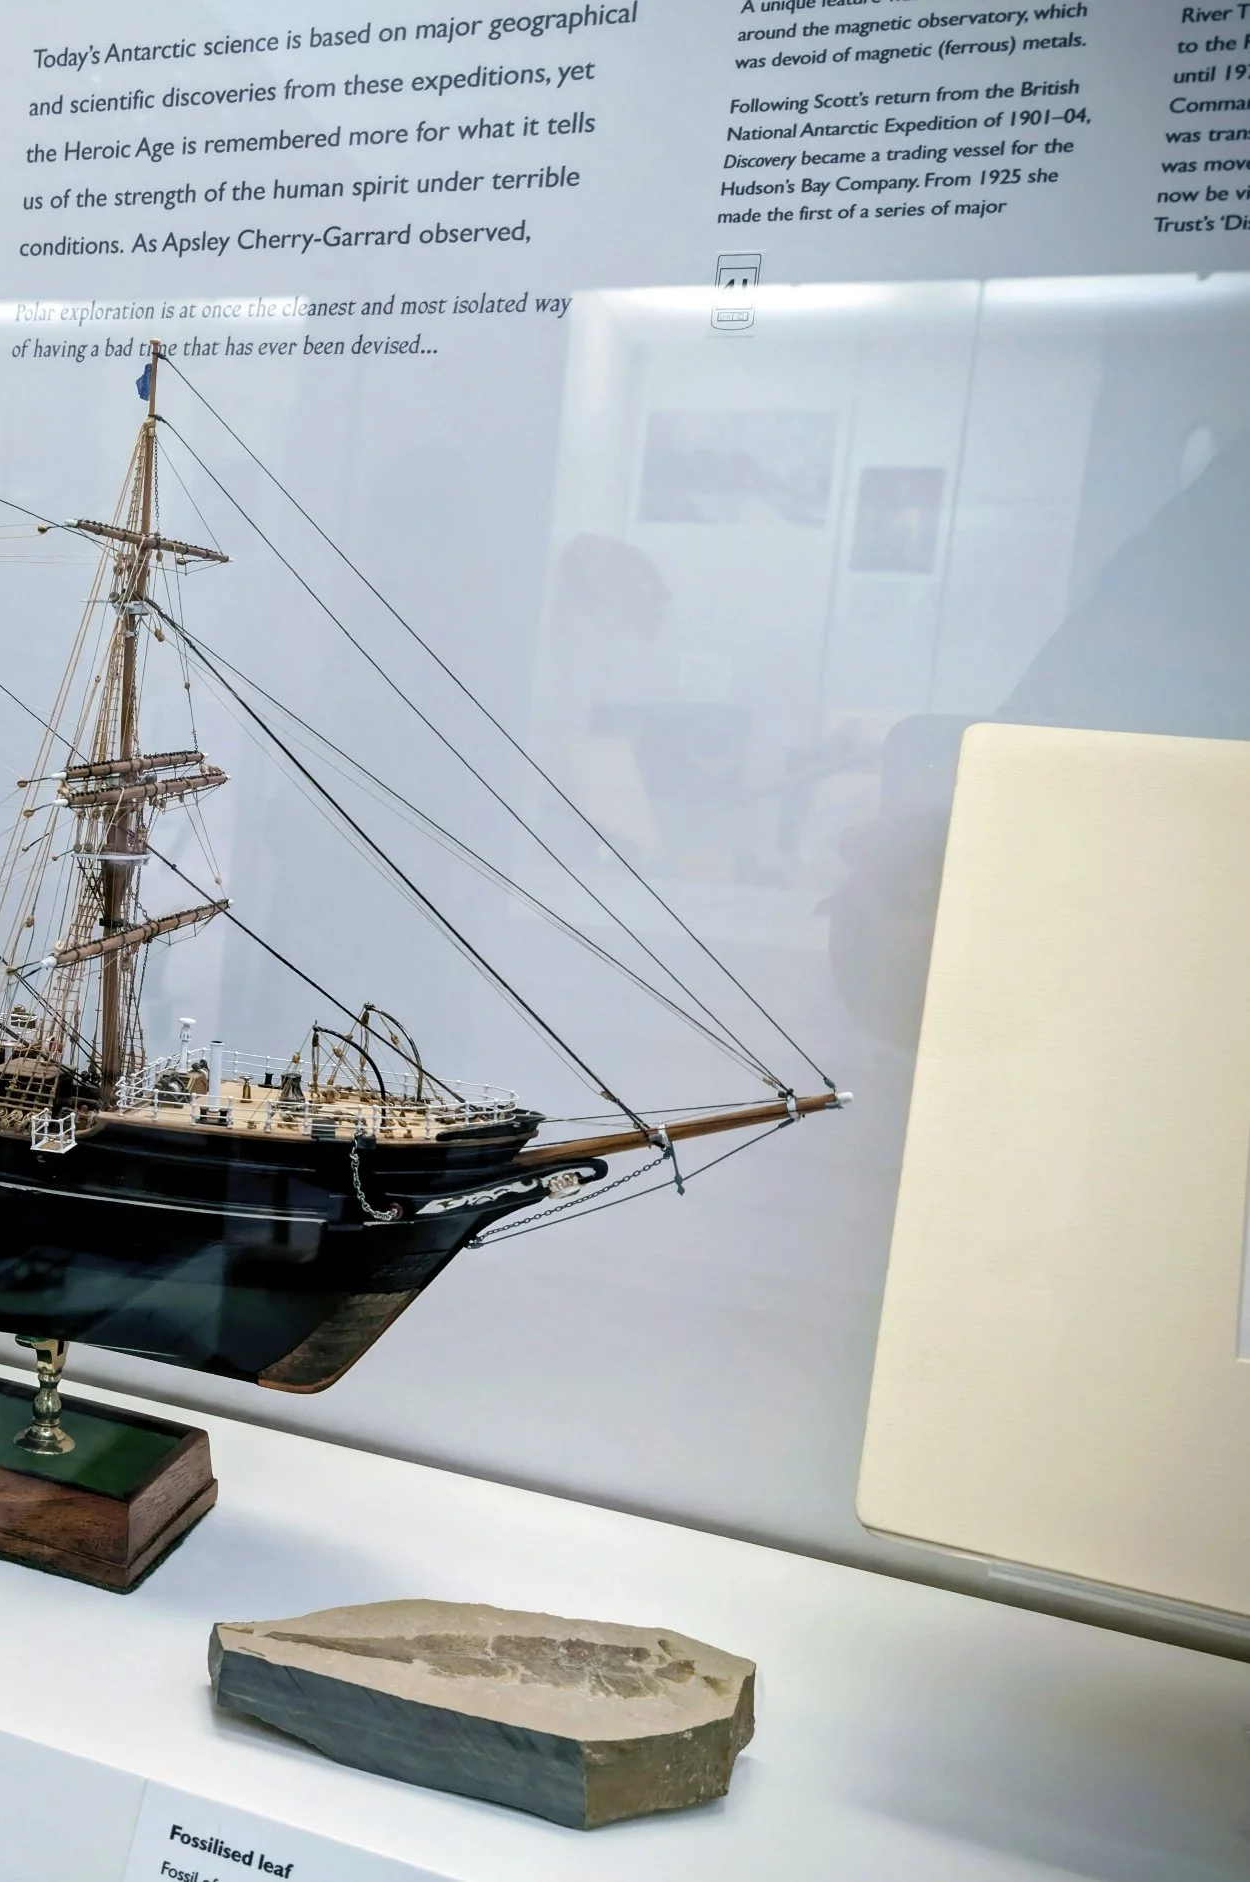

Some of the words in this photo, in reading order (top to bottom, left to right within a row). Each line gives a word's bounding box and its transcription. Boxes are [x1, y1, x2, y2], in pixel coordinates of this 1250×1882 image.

[737, 22, 797, 42] around
[802, 21, 830, 37] the
[834, 15, 912, 38] magnetic
[917, 10, 1029, 29] observatory,
[1033, 1, 1088, 20] which
[740, 0, 755, 15] A
[761, 0, 817, 15] unique
[1181, 7, 1234, 23] River
[103, 38, 197, 64] Antarctic
[203, 35, 279, 56] science
[286, 30, 302, 50] is
[309, 22, 371, 48] based
[378, 26, 407, 43] on
[415, 17, 483, 44] major
[488, 0, 638, 41] geographical
[1177, 41, 1199, 54] to
[1205, 35, 1237, 52] the
[734, 57, 767, 69] was
[771, 48, 828, 67] devoid
[832, 46, 853, 63] of
[855, 42, 933, 64] magnetic
[938, 35, 1016, 61] (ferrous)
[1022, 31, 1086, 51] metals.
[1173, 65, 1217, 84] until
[730, 96, 810, 115] Following
[874, 92, 931, 106] return
[936, 86, 979, 102] from
[985, 83, 1015, 99] the
[1020, 78, 1080, 97] British
[1169, 97, 1250, 114] Comma
[726, 123, 798, 143] National
[800, 118, 879, 138] Antarctic
[884, 115, 978, 137] Expedition
[983, 111, 1005, 128] of
[1165, 131, 1202, 144] was
[1208, 128, 1250, 142] tran
[723, 154, 797, 171] Discovery
[801, 150, 866, 166] became
[871, 151, 881, 162] a
[886, 144, 949, 164] trading
[952, 140, 1006, 158] vessel
[1011, 139, 1039, 156] for
[1044, 137, 1074, 154] the
[1161, 161, 1198, 173] was
[801, 178, 831, 197] Bay
[835, 176, 920, 195] Company.
[924, 172, 971, 188] From
[980, 168, 1022, 186] 1925
[1027, 167, 1059, 184] she
[1157, 190, 1200, 203] now
[1205, 185, 1229, 202] be
[717, 207, 762, 224] made
[766, 206, 794, 222] the
[799, 205, 833, 221] first
[837, 203, 858, 220] of
[859, 208, 869, 219] a
[874, 202, 925, 218] series
[930, 199, 952, 216] of
[954, 199, 1008, 219] major
[19, 235, 124, 257] conditions.
[131, 233, 158, 253] As
[161, 230, 231, 258] Apsley
[237, 223, 412, 255] Cherry-Garrard
[419, 219, 531, 244] observed,
[15, 301, 55, 322] Polar
[60, 299, 155, 327] exploration
[159, 301, 175, 320] is
[178, 304, 198, 319] at
[201, 304, 242, 319] once
[248, 296, 277, 318] the
[282, 294, 358, 319] cleanest
[360, 293, 396, 316] and
[399, 298, 449, 316] most
[451, 290, 529, 315] isolated
[534, 297, 574, 319] way
[11, 338, 32, 358] of
[34, 338, 87, 363] having
[90, 344, 100, 358] a
[104, 337, 134, 357] bad
[183, 336, 221, 356] that
[224, 335, 254, 356] has
[258, 341, 298, 356] ever
[303, 334, 345, 355] been
[351, 333, 438, 355] devised...
[169, 1824, 255, 1867] Fossilised
[257, 1853, 294, 1879] leaf
[160, 1860, 199, 1882] Fossil
